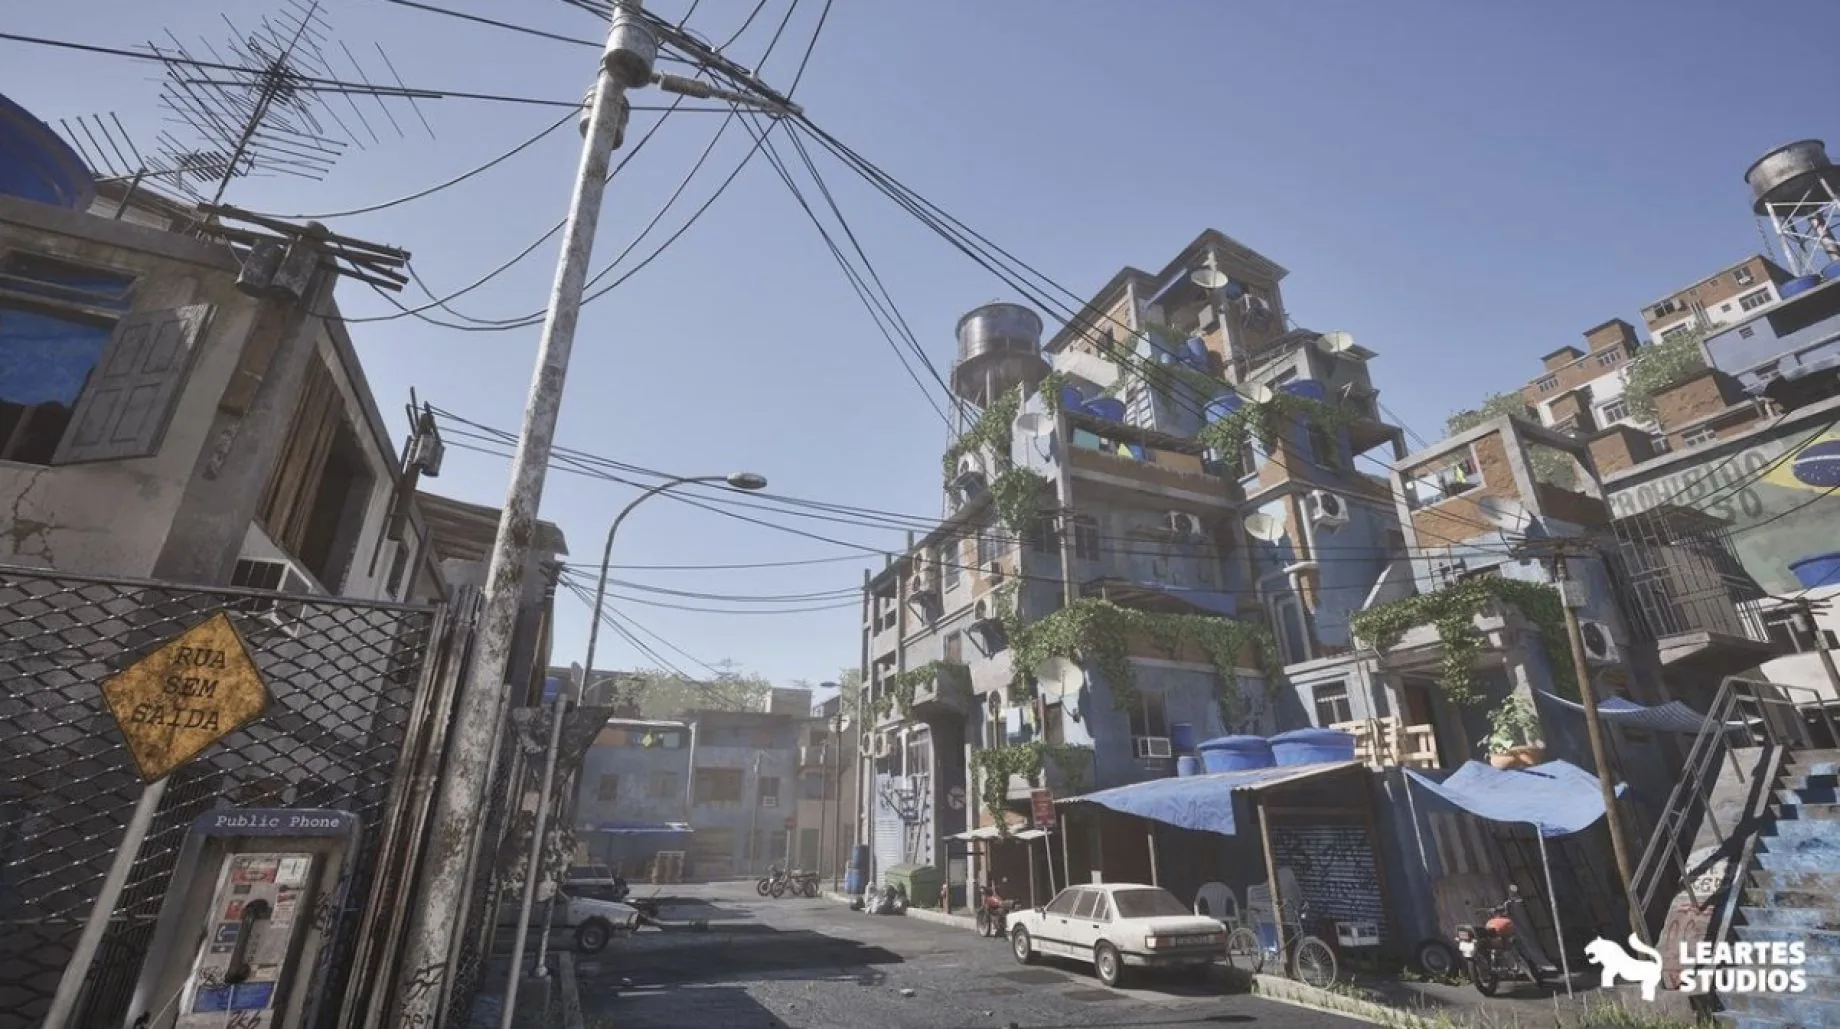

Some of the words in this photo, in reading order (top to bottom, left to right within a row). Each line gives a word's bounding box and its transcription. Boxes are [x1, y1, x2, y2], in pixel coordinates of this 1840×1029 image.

[174, 646, 226, 670] RUA
[163, 675, 220, 699] SEM
[214, 815, 280, 828] Public
[288, 815, 340, 828] Phone
